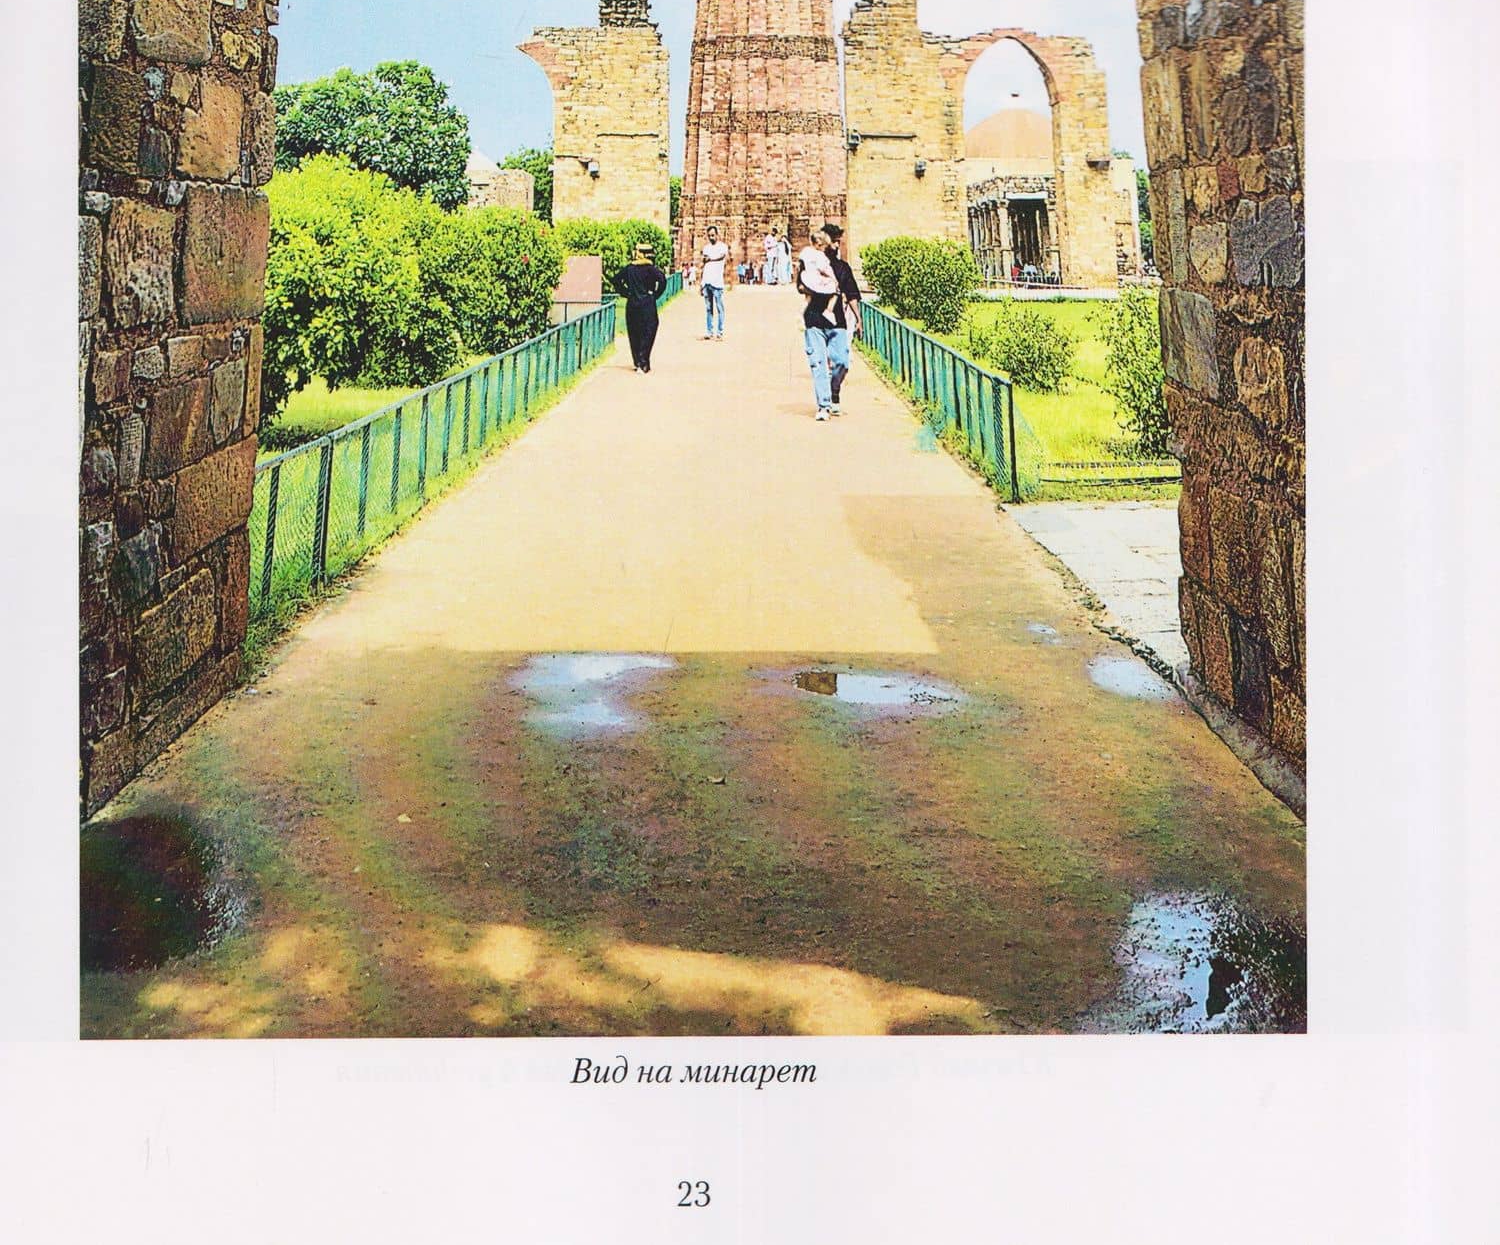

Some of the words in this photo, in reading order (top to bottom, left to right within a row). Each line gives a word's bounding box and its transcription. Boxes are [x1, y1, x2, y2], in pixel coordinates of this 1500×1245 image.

[569, 1054, 629, 1085] Вид
[637, 1064, 673, 1084] на
[679, 1063, 818, 1091] минарет
[677, 1180, 711, 1208] 23
